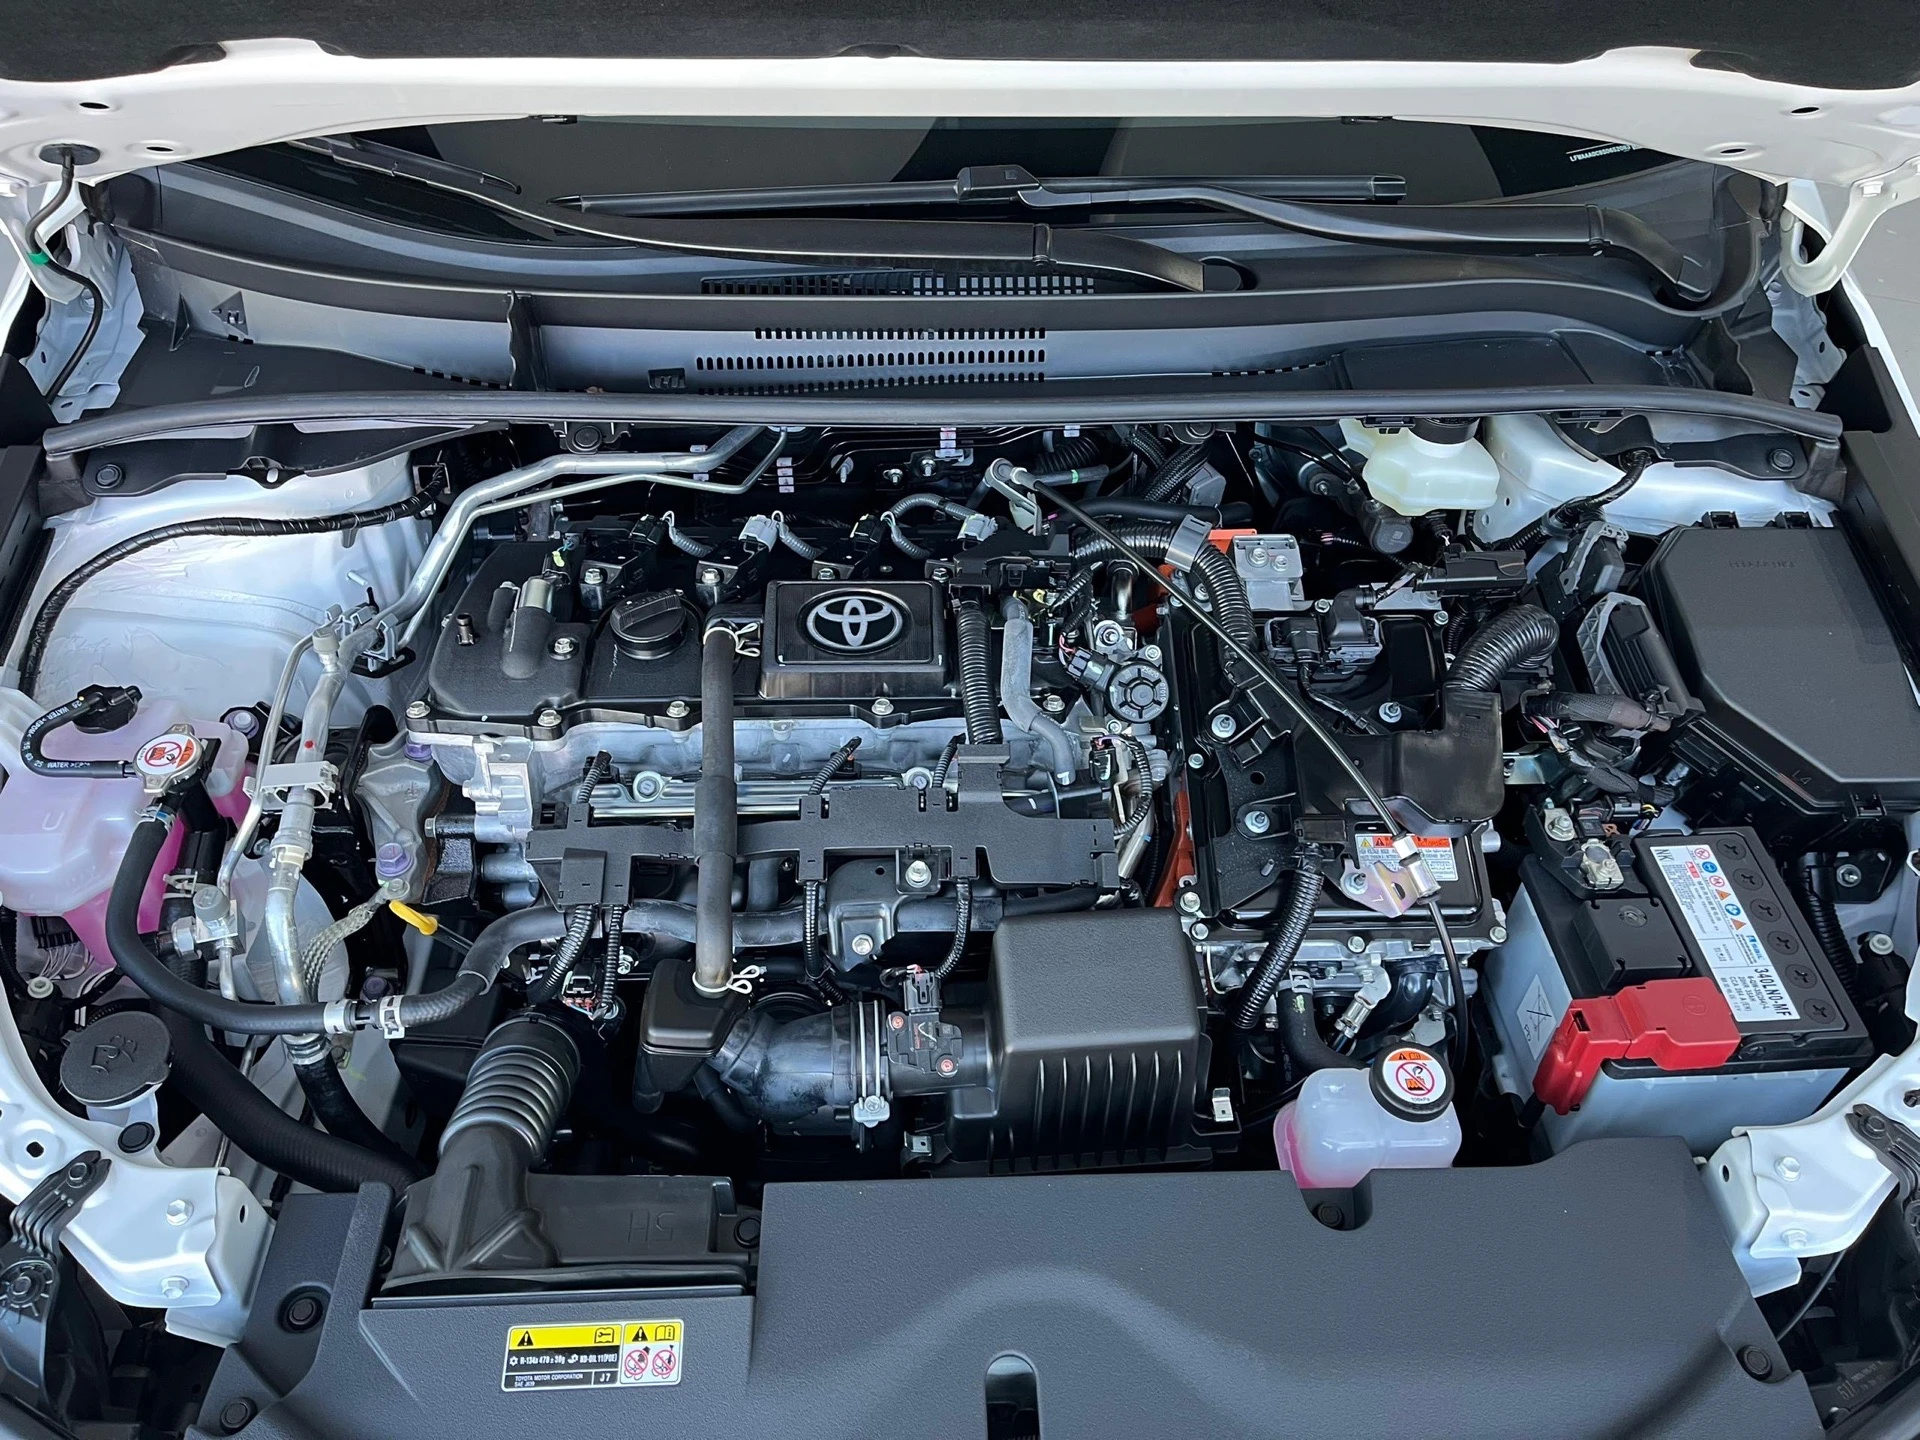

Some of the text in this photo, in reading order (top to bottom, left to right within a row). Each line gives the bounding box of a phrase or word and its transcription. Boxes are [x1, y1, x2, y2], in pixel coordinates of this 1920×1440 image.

[47, 706, 70, 720] WATER
[1729, 976, 1739, 986] CCA
[551, 1373, 584, 1381] CORPORATION
